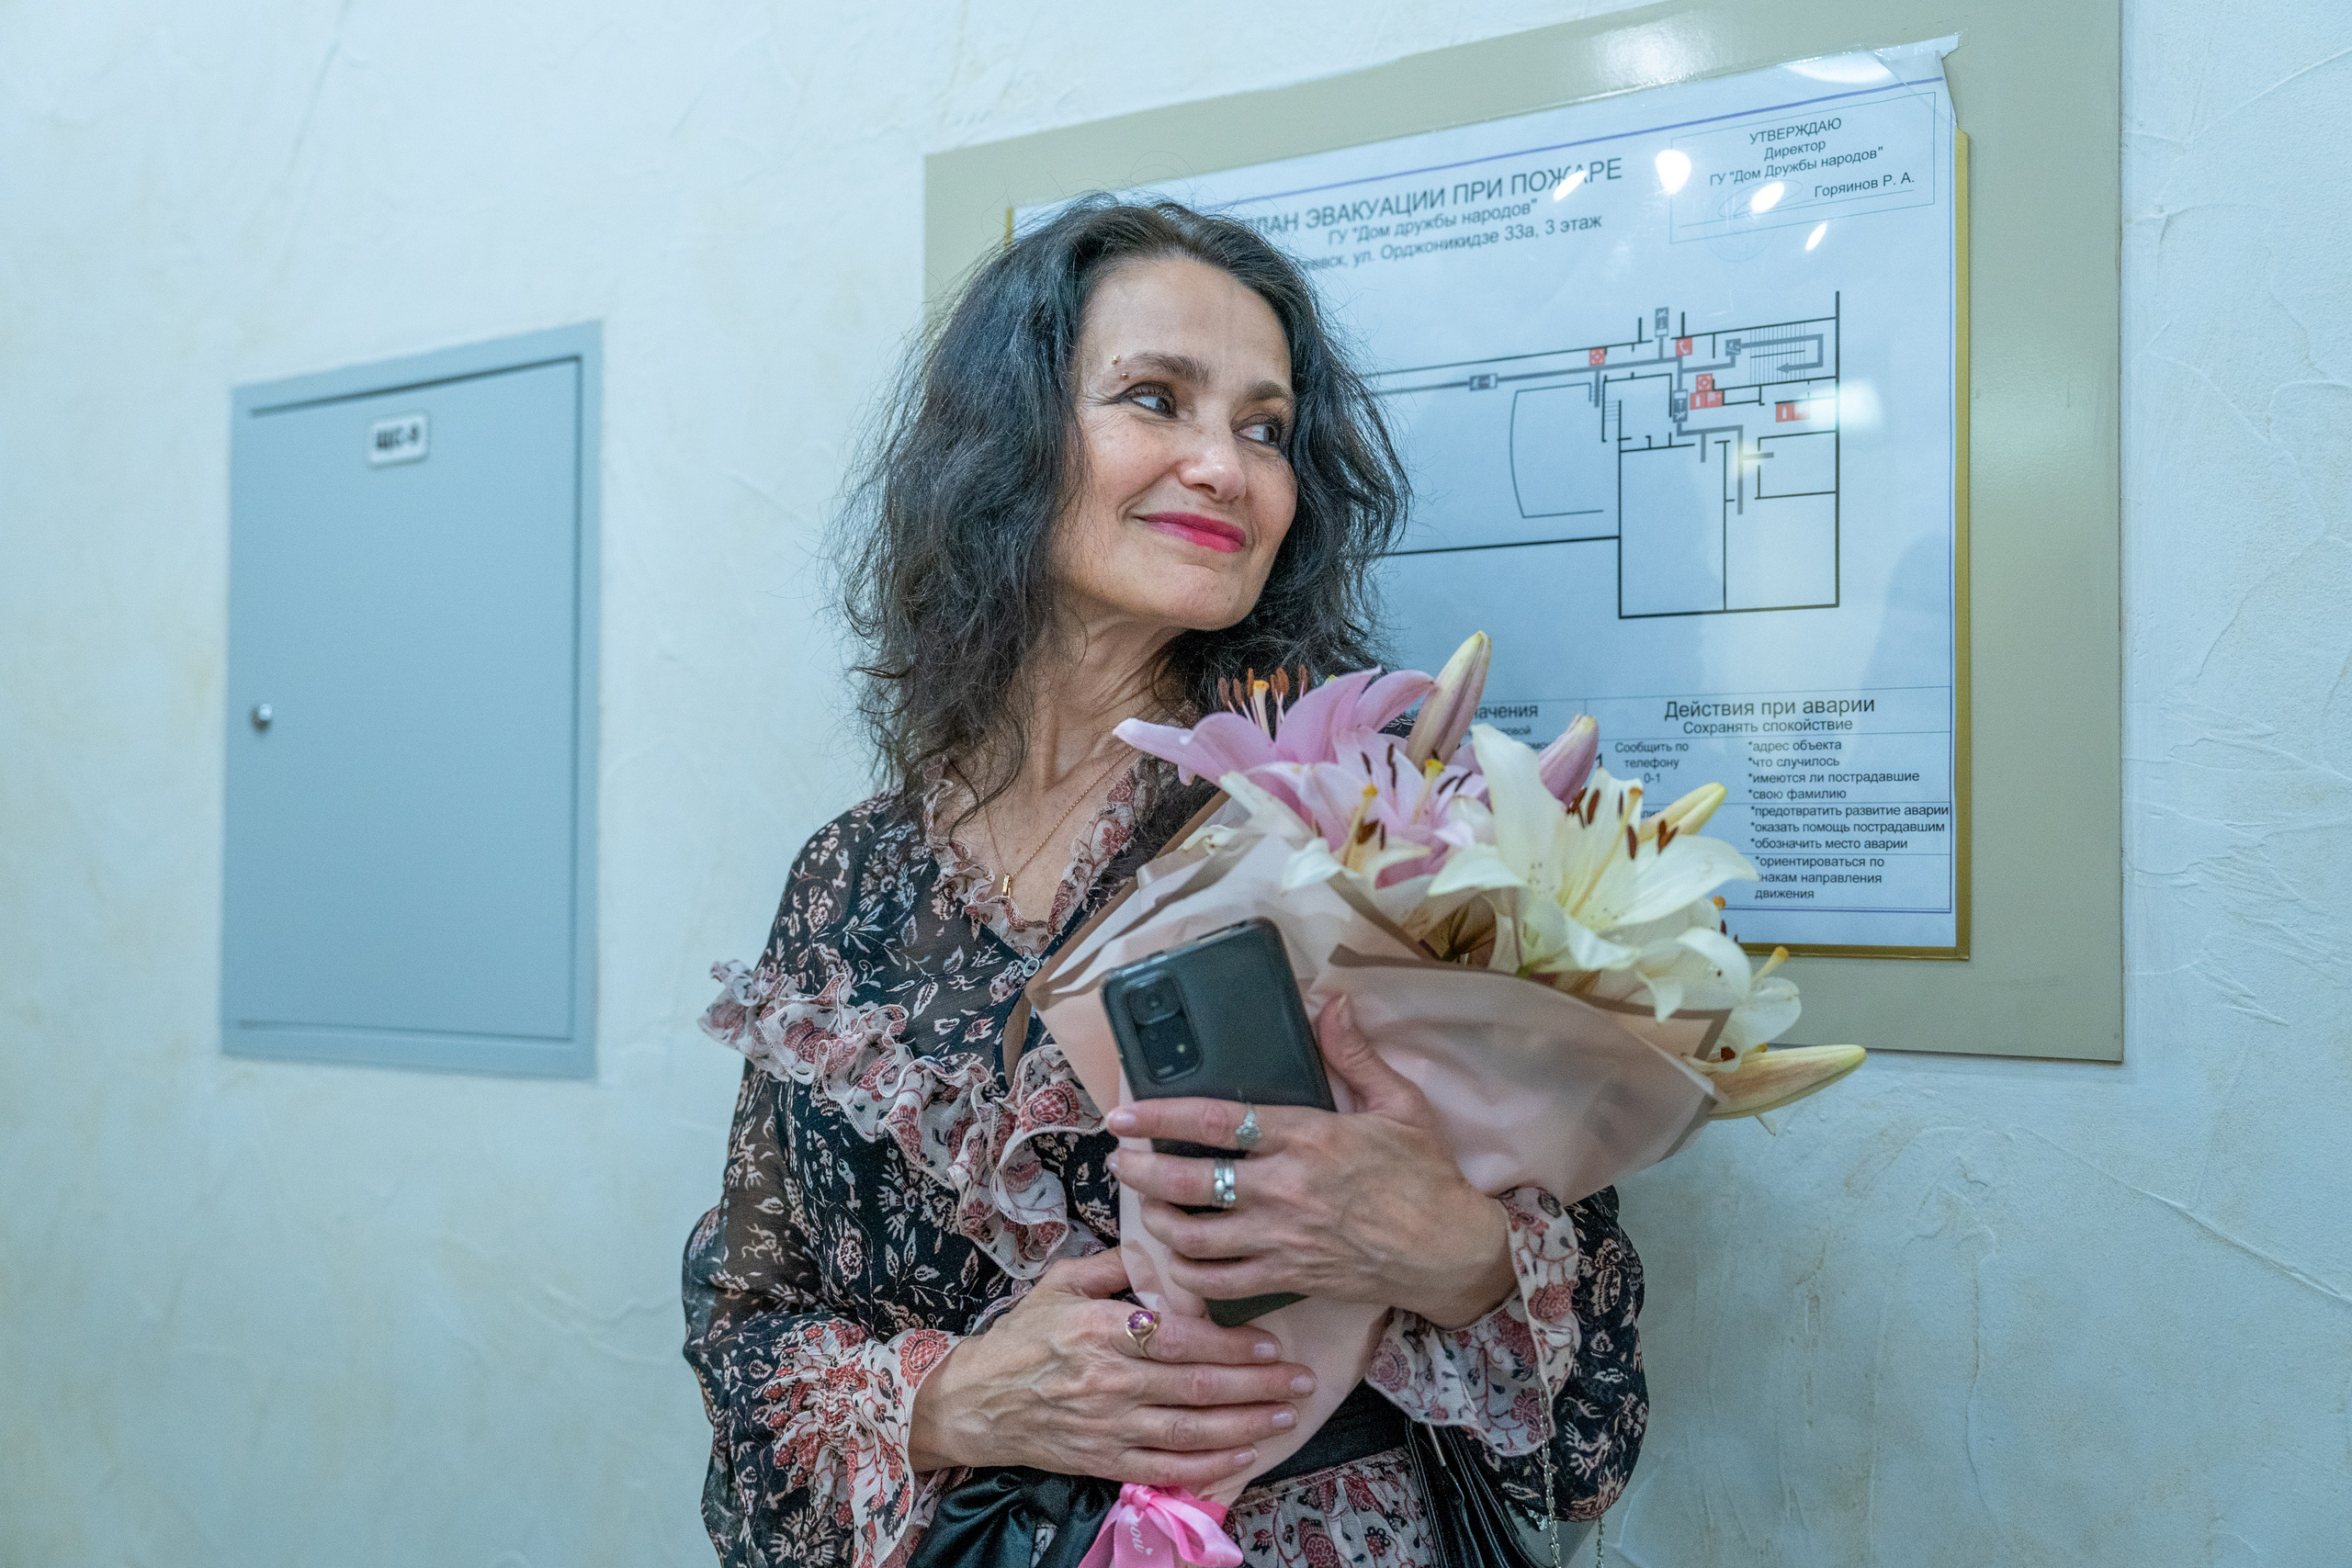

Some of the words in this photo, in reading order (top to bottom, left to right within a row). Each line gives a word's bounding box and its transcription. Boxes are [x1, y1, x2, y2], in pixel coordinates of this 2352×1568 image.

[1749, 118, 1842, 144] УТВЕРЖДАЮ
[1764, 140, 1826, 162] Директор
[1710, 173, 1726, 186] ГУ
[1729, 168, 1761, 184] "Дом
[1765, 159, 1817, 178] Дружбы
[1821, 146, 1883, 167] народов"
[1815, 178, 1879, 198] Горяинов
[1883, 174, 1896, 186] Р.
[1900, 172, 1916, 184] А.
[1305, 187, 1445, 230] ЭВАКУАЦИИ
[1453, 177, 1503, 205] ПРИ
[1328, 230, 1350, 246] ГУ
[1353, 225, 1390, 243] "Дом
[1395, 212, 1457, 237] дружбы
[1462, 198, 1538, 226] народов"
[1353, 249, 1376, 268] ул.
[1380, 231, 1499, 262] Орджоникидзе
[1505, 225, 1540, 242] 33а,
[1545, 219, 1555, 235] 3
[1561, 215, 1603, 233] этаж
[1475, 705, 1539, 719] ачения
[1664, 701, 1755, 721] Действия
[1760, 701, 1796, 718] при
[1803, 698, 1875, 718] аварии
[1682, 721, 1758, 736] Сохранять
[1762, 718, 1853, 732] спокойствие
[1614, 741, 1672, 753] Сообщить
[1675, 742, 1690, 752] по
[1792, 739, 1842, 751] объекта
[1624, 757, 1679, 770] телефону
[1777, 756, 1840, 772] случилось
[1643, 773, 1661, 784] 0-1
[1809, 773, 1826, 783] ли
[1828, 771, 1920, 784] пострадавшие
[1787, 787, 1847, 801] фамилию
[1845, 806, 1902, 818] развитие
[1904, 806, 1950, 818] аварии
[1803, 821, 1850, 834] помощь
[1853, 821, 1945, 835] пострадавшим
[1825, 839, 1861, 850] место
[1863, 839, 1908, 851] аварии
[1869, 857, 1885, 867] по
[1801, 873, 1883, 886] направления
[1754, 888, 1815, 899] движения
